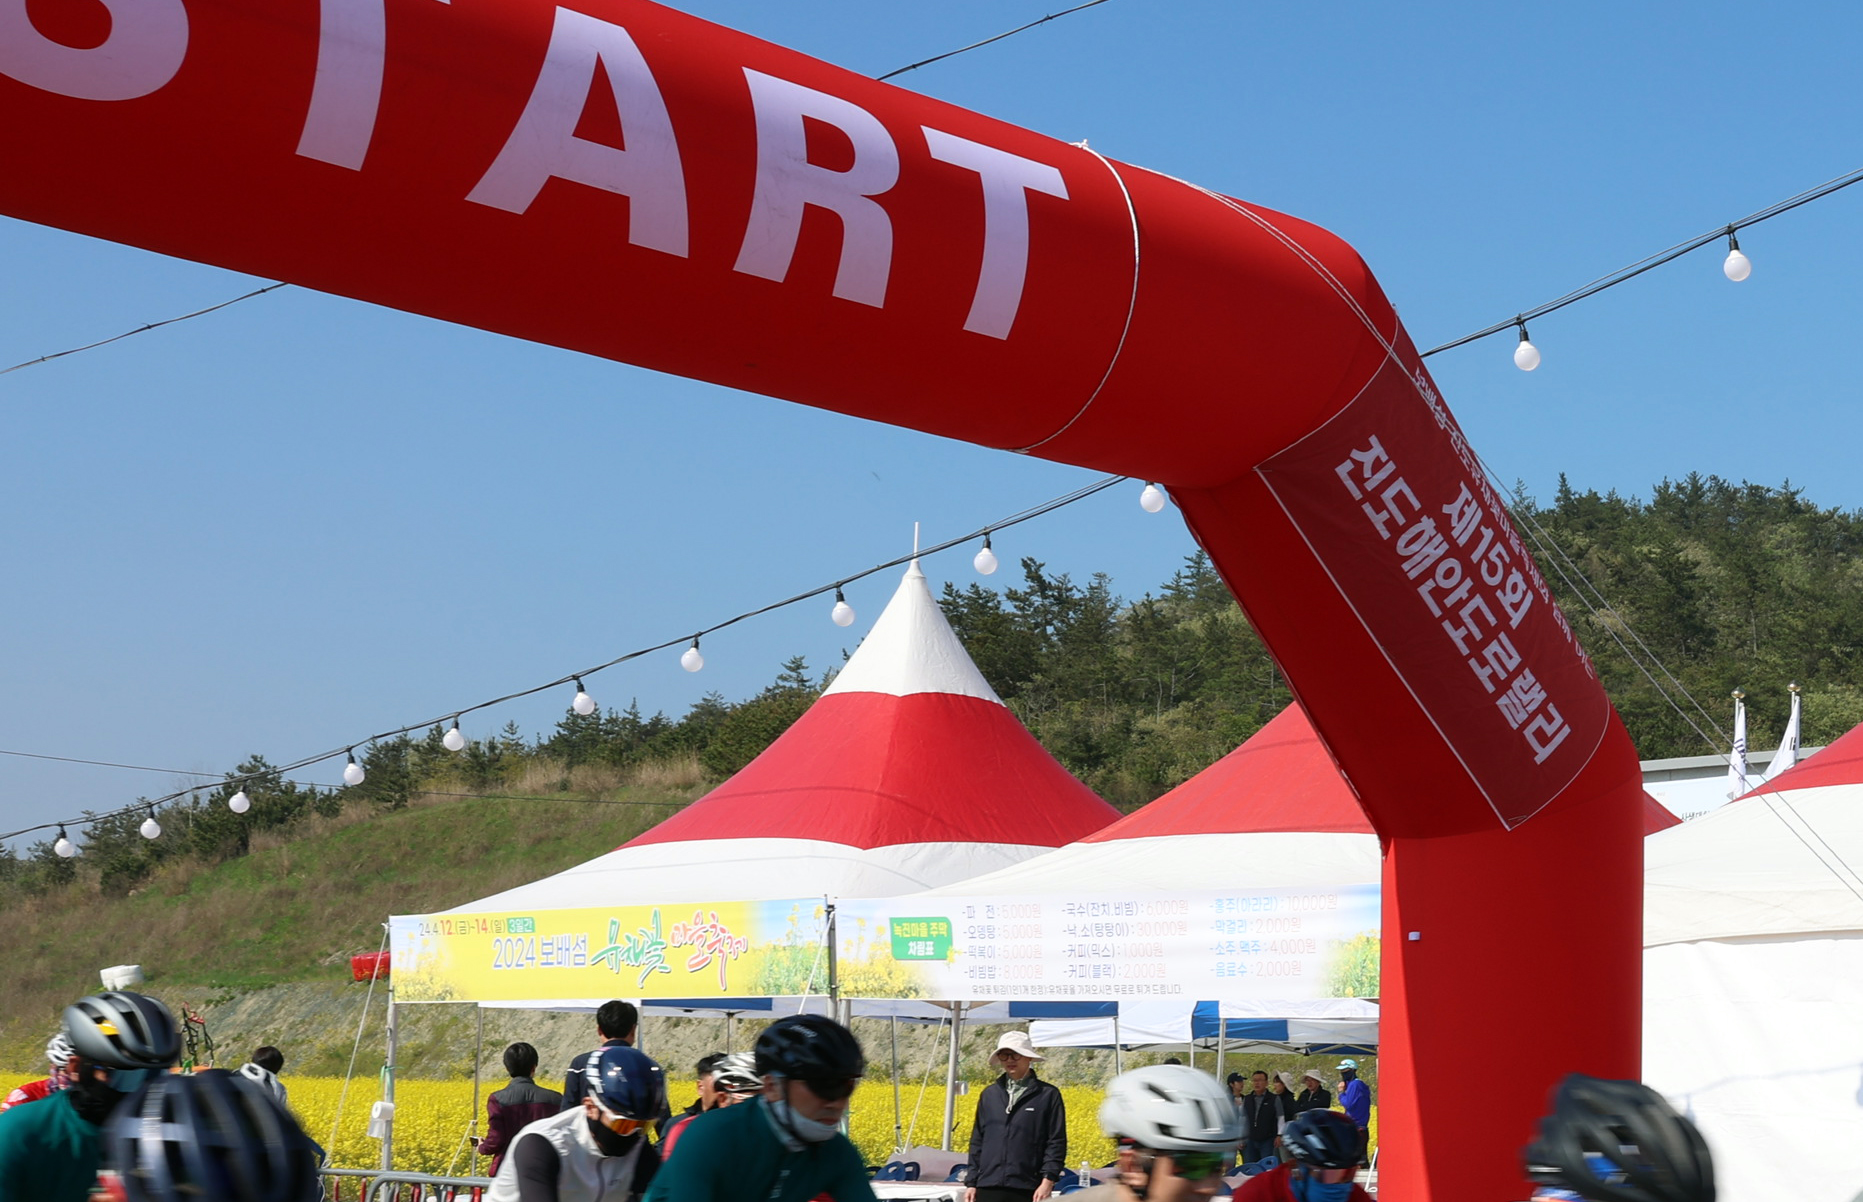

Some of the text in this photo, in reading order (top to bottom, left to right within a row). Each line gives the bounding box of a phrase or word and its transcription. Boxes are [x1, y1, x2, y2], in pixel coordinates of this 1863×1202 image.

[1441, 480, 1534, 631] 제15회
[1334, 433, 1571, 766] 진도해안도로랠리
[507, 916, 536, 935] 3일간
[493, 937, 536, 969] 2024
[540, 934, 588, 968] 보배섬
[907, 940, 935, 957] 차림표
